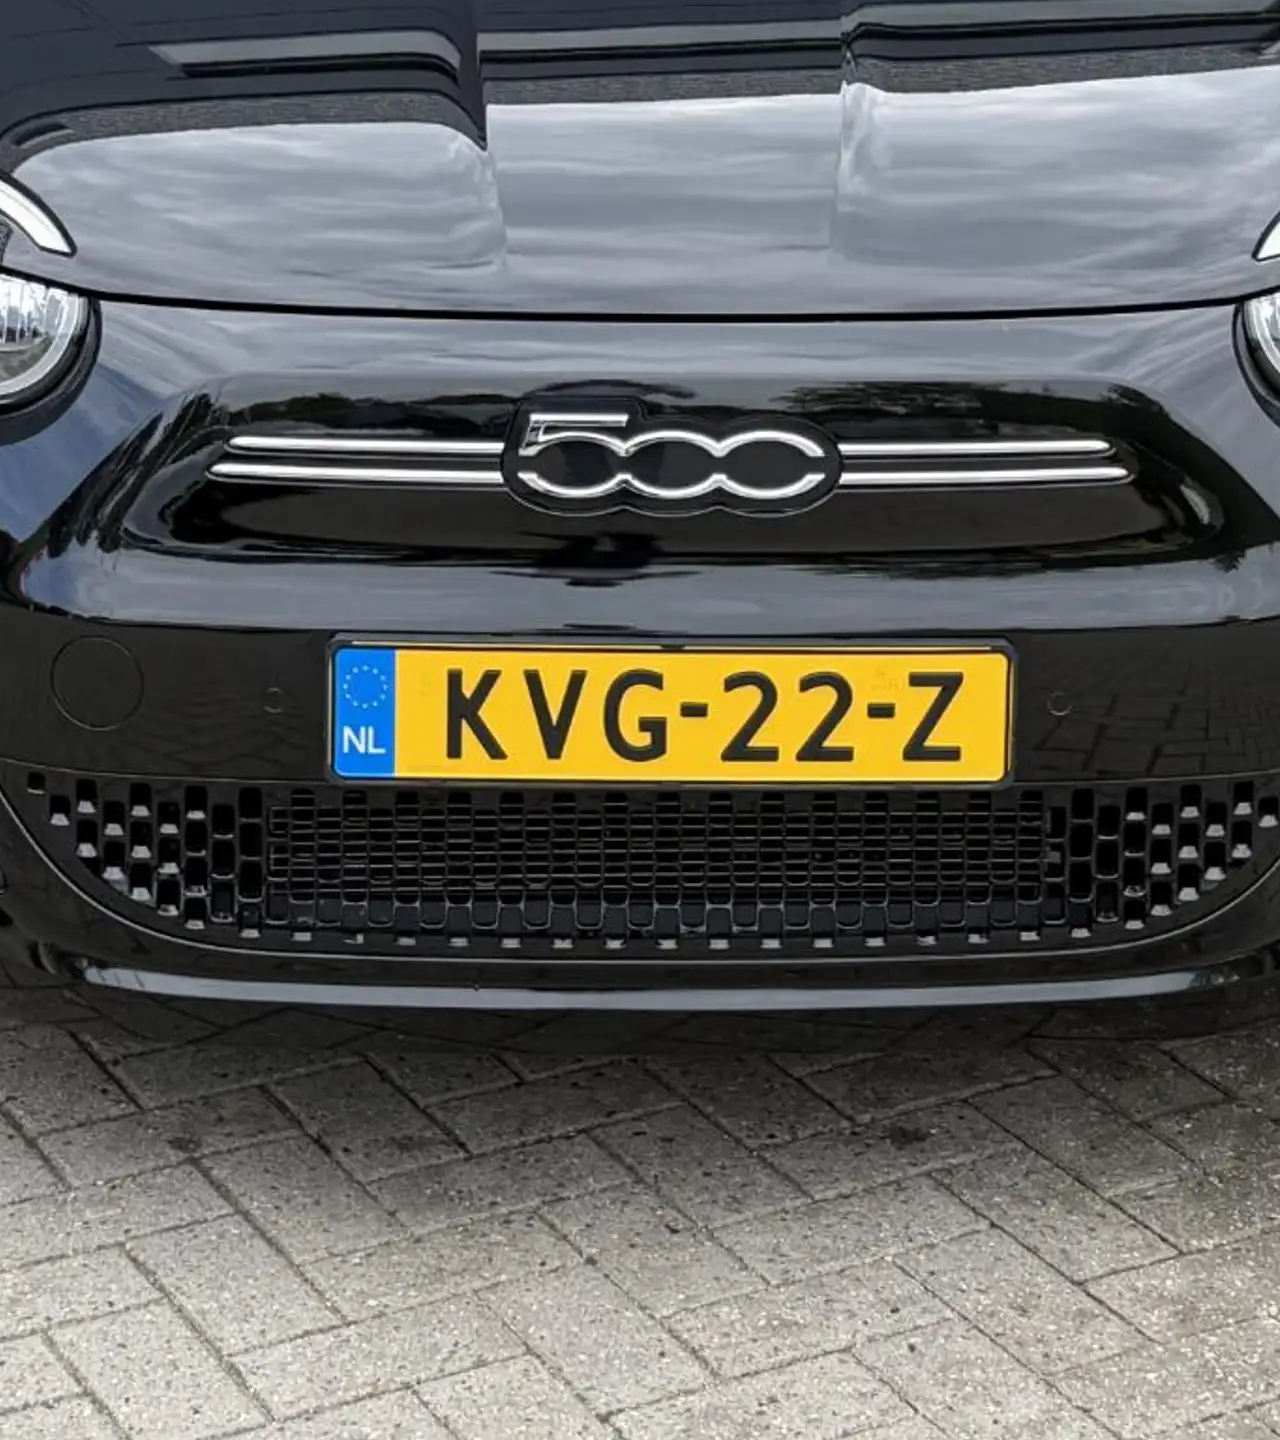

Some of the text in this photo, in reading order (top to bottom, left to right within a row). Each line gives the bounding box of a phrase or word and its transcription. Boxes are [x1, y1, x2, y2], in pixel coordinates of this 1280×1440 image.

[517, 413, 826, 500] 500
[342, 667, 965, 763] NL KVG-22-Z
